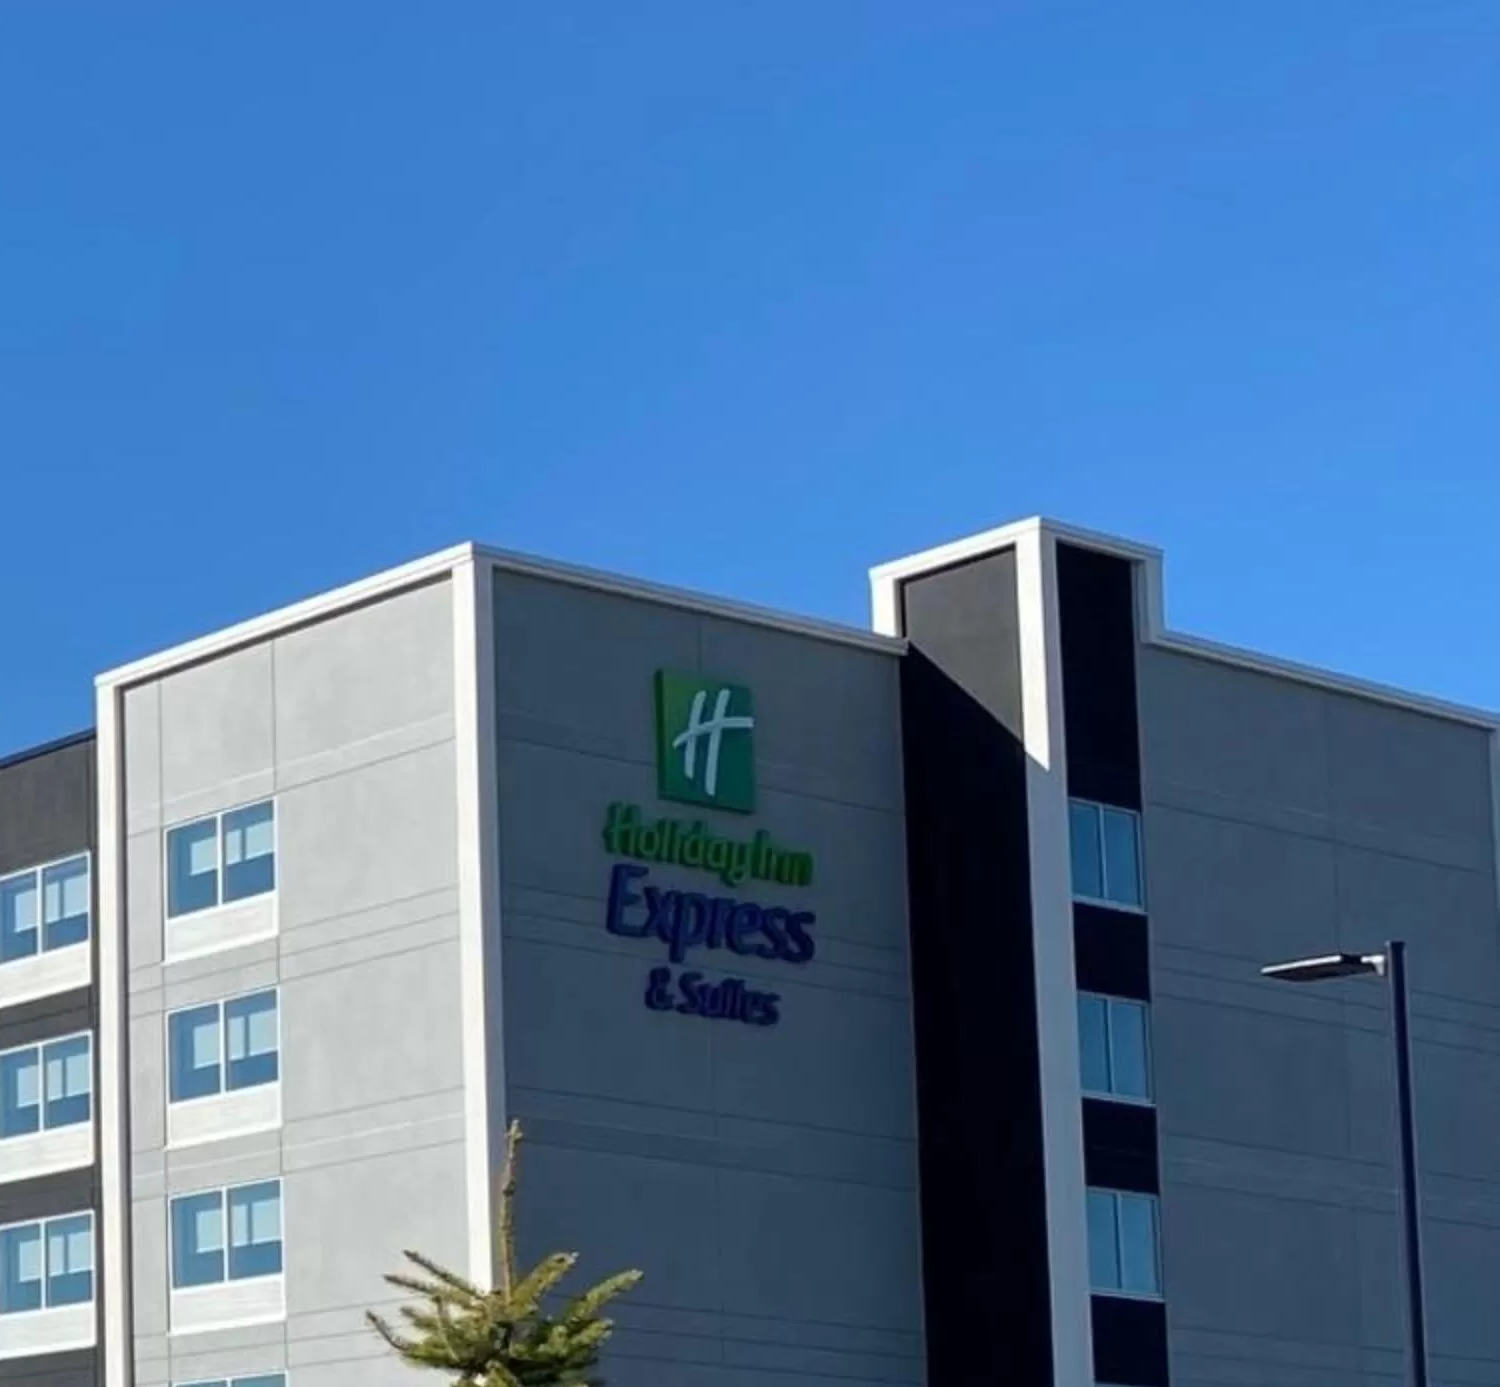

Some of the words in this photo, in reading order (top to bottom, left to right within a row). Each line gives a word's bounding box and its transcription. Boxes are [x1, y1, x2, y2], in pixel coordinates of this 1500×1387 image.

[673, 689, 754, 796] H
[606, 864, 816, 963] Express
[645, 967, 675, 1011] &
[676, 972, 781, 1026] Suites
